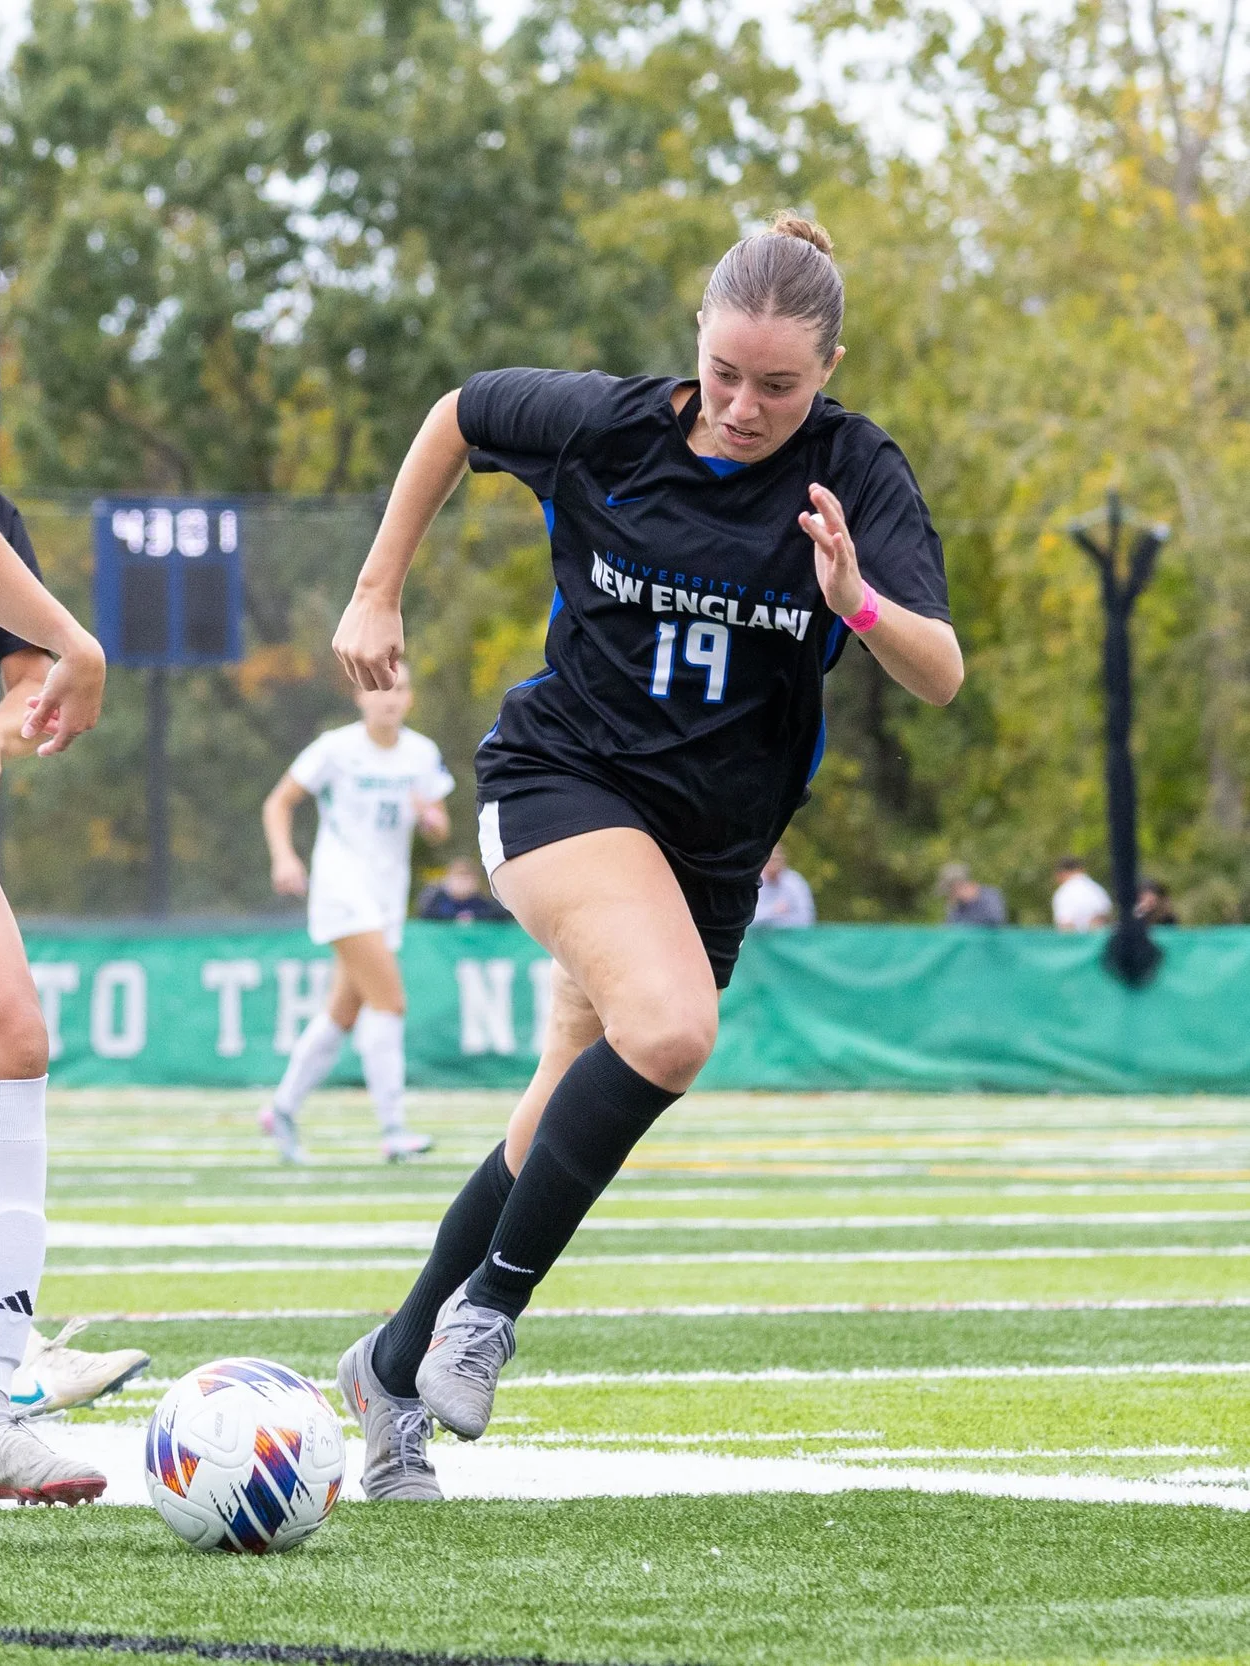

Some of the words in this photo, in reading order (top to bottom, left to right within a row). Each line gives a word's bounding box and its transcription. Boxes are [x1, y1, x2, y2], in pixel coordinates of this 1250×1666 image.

[591, 550, 645, 604] NEW
[606, 550, 747, 597] UNIVERSITY
[764, 590, 792, 604] OF
[650, 620, 731, 704] 19
[32, 961, 147, 1059] TO
[203, 958, 332, 1057] TH
